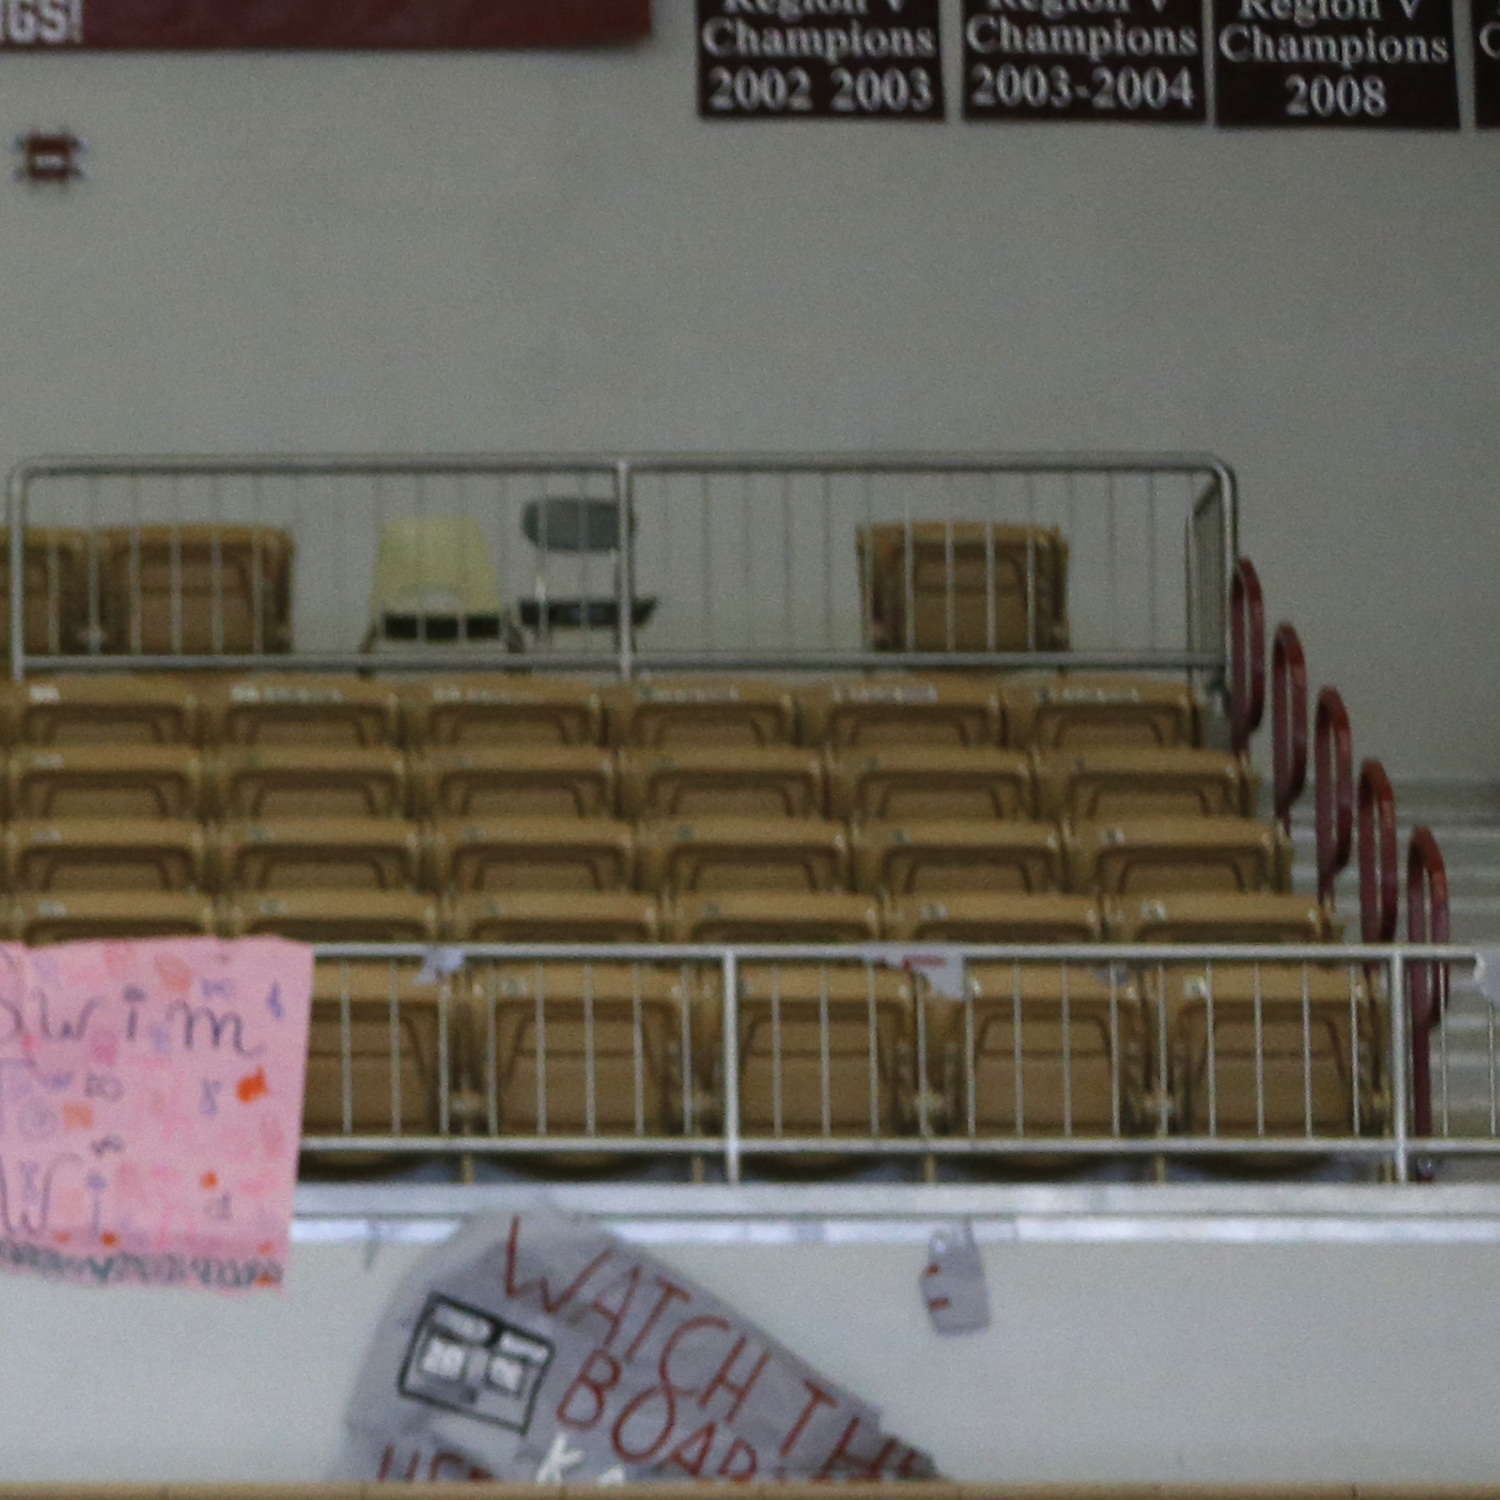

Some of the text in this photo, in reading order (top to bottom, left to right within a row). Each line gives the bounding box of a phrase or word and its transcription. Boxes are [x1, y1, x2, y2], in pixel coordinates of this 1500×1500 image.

[702, 16, 937, 65] Champions
[966, 14, 1198, 62] Champions
[1218, 22, 1450, 70] Champions
[709, 66, 933, 112] 2002 2003
[970, 63, 1195, 110] 2003-2004
[1284, 74, 1388, 117] 2008
[502, 1212, 771, 1424] WATCH
